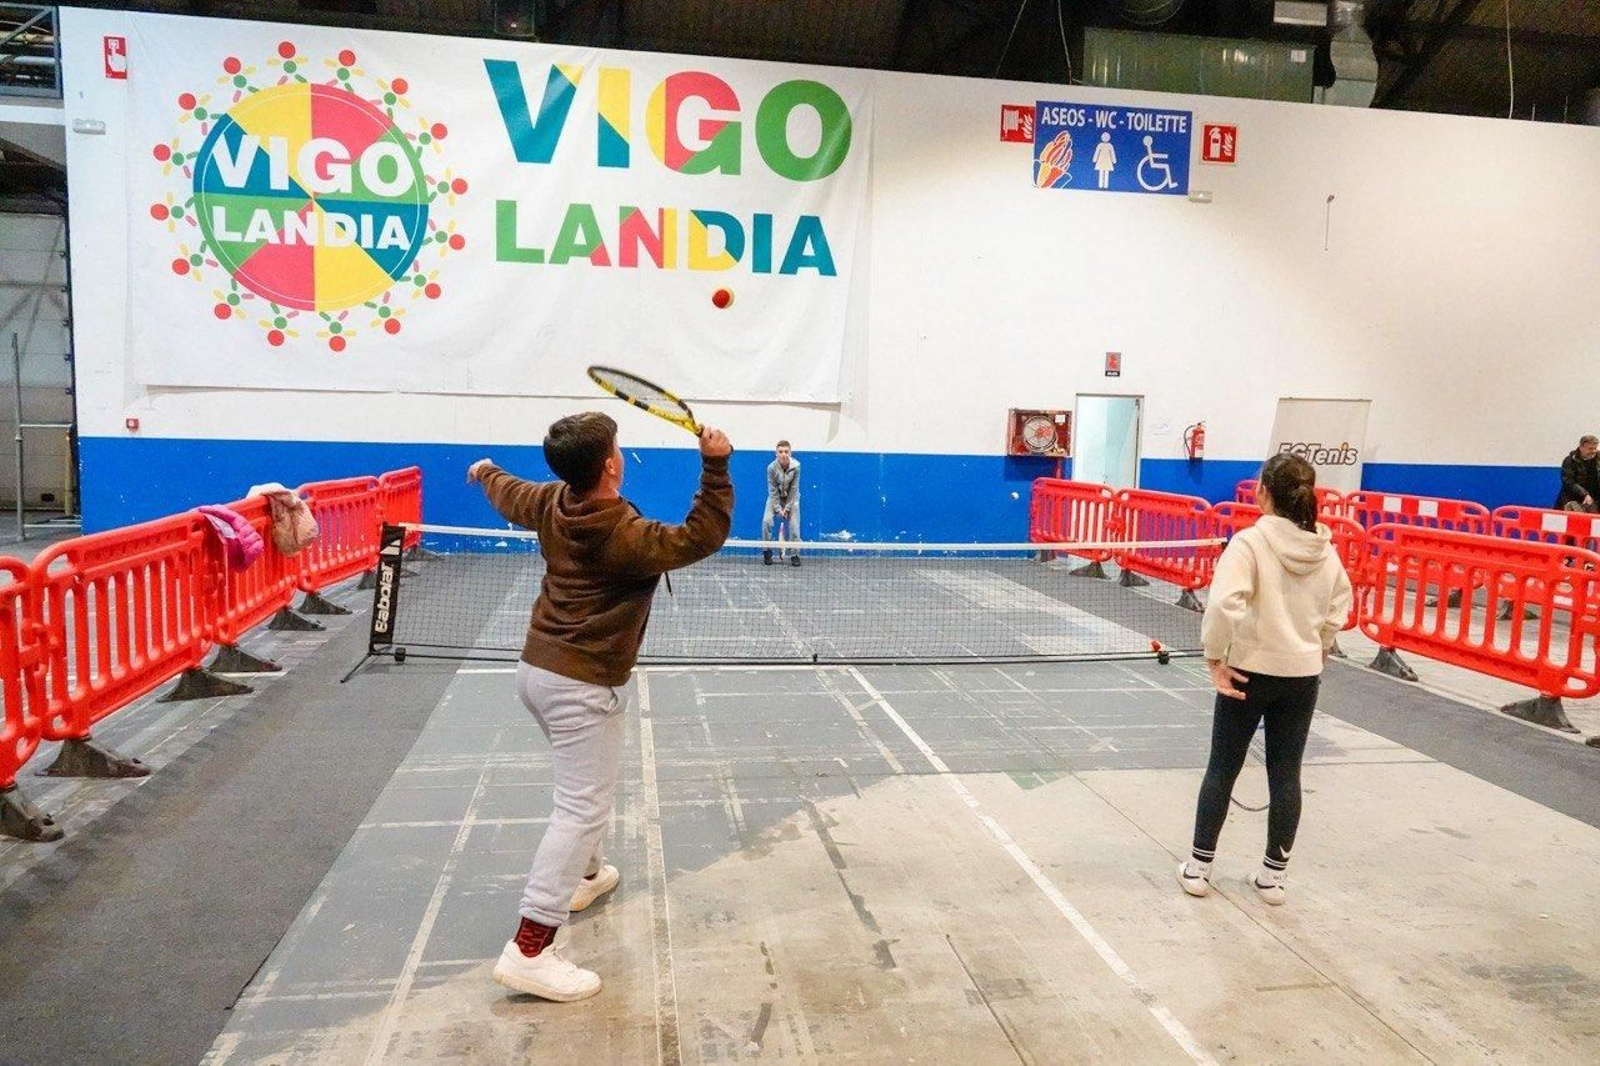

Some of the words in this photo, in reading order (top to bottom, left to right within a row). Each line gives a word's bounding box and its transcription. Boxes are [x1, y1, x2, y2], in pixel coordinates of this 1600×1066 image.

[483, 58, 852, 182] VIGO
[1041, 106, 1086, 127] ASEOS
[1095, 110, 1117, 129] WC
[1126, 112, 1187, 133] TOILETTE
[211, 135, 415, 196] VIGO
[212, 206, 410, 250] LANDIA
[495, 199, 837, 277] LANDIA
[374, 561, 394, 633] Babolat
